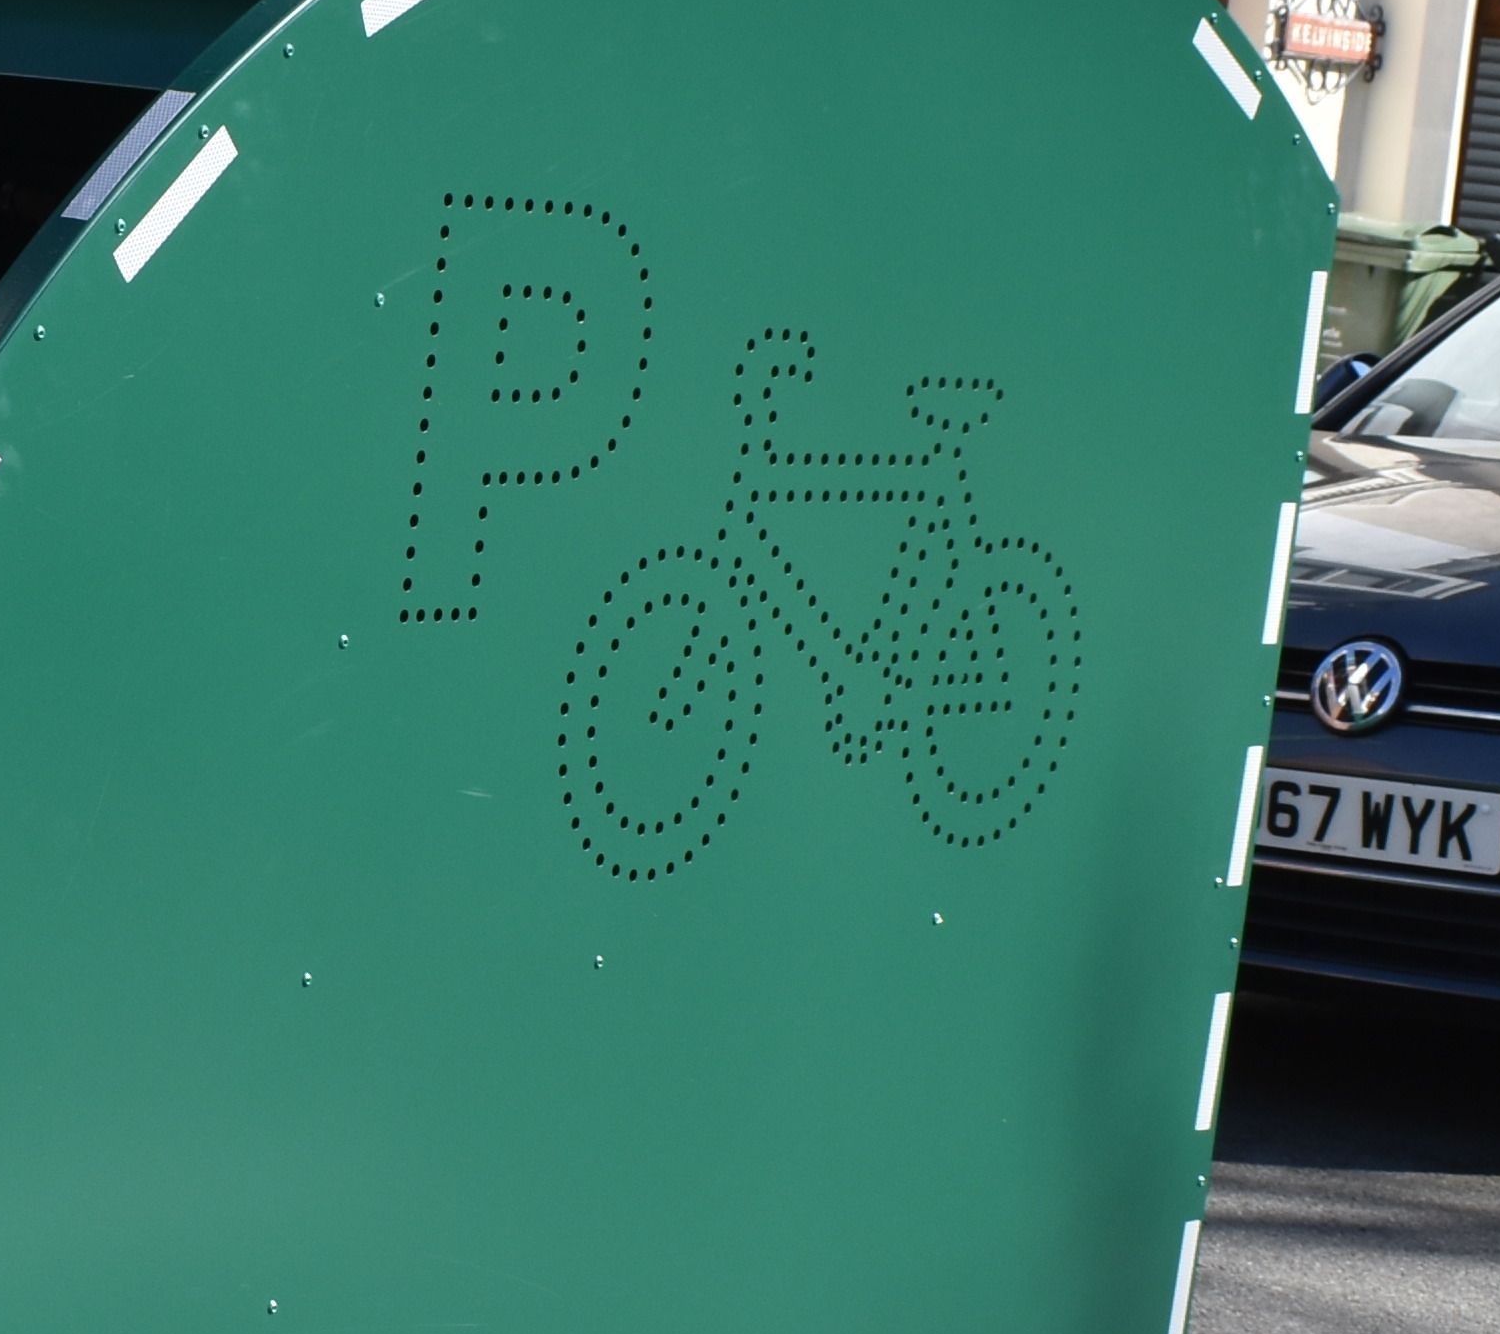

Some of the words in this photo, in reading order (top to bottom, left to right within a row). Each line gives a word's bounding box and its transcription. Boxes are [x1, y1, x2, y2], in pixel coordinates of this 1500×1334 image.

[398, 190, 654, 624] P
[1266, 779, 1342, 843] 67
[1361, 790, 1478, 862] WYK
